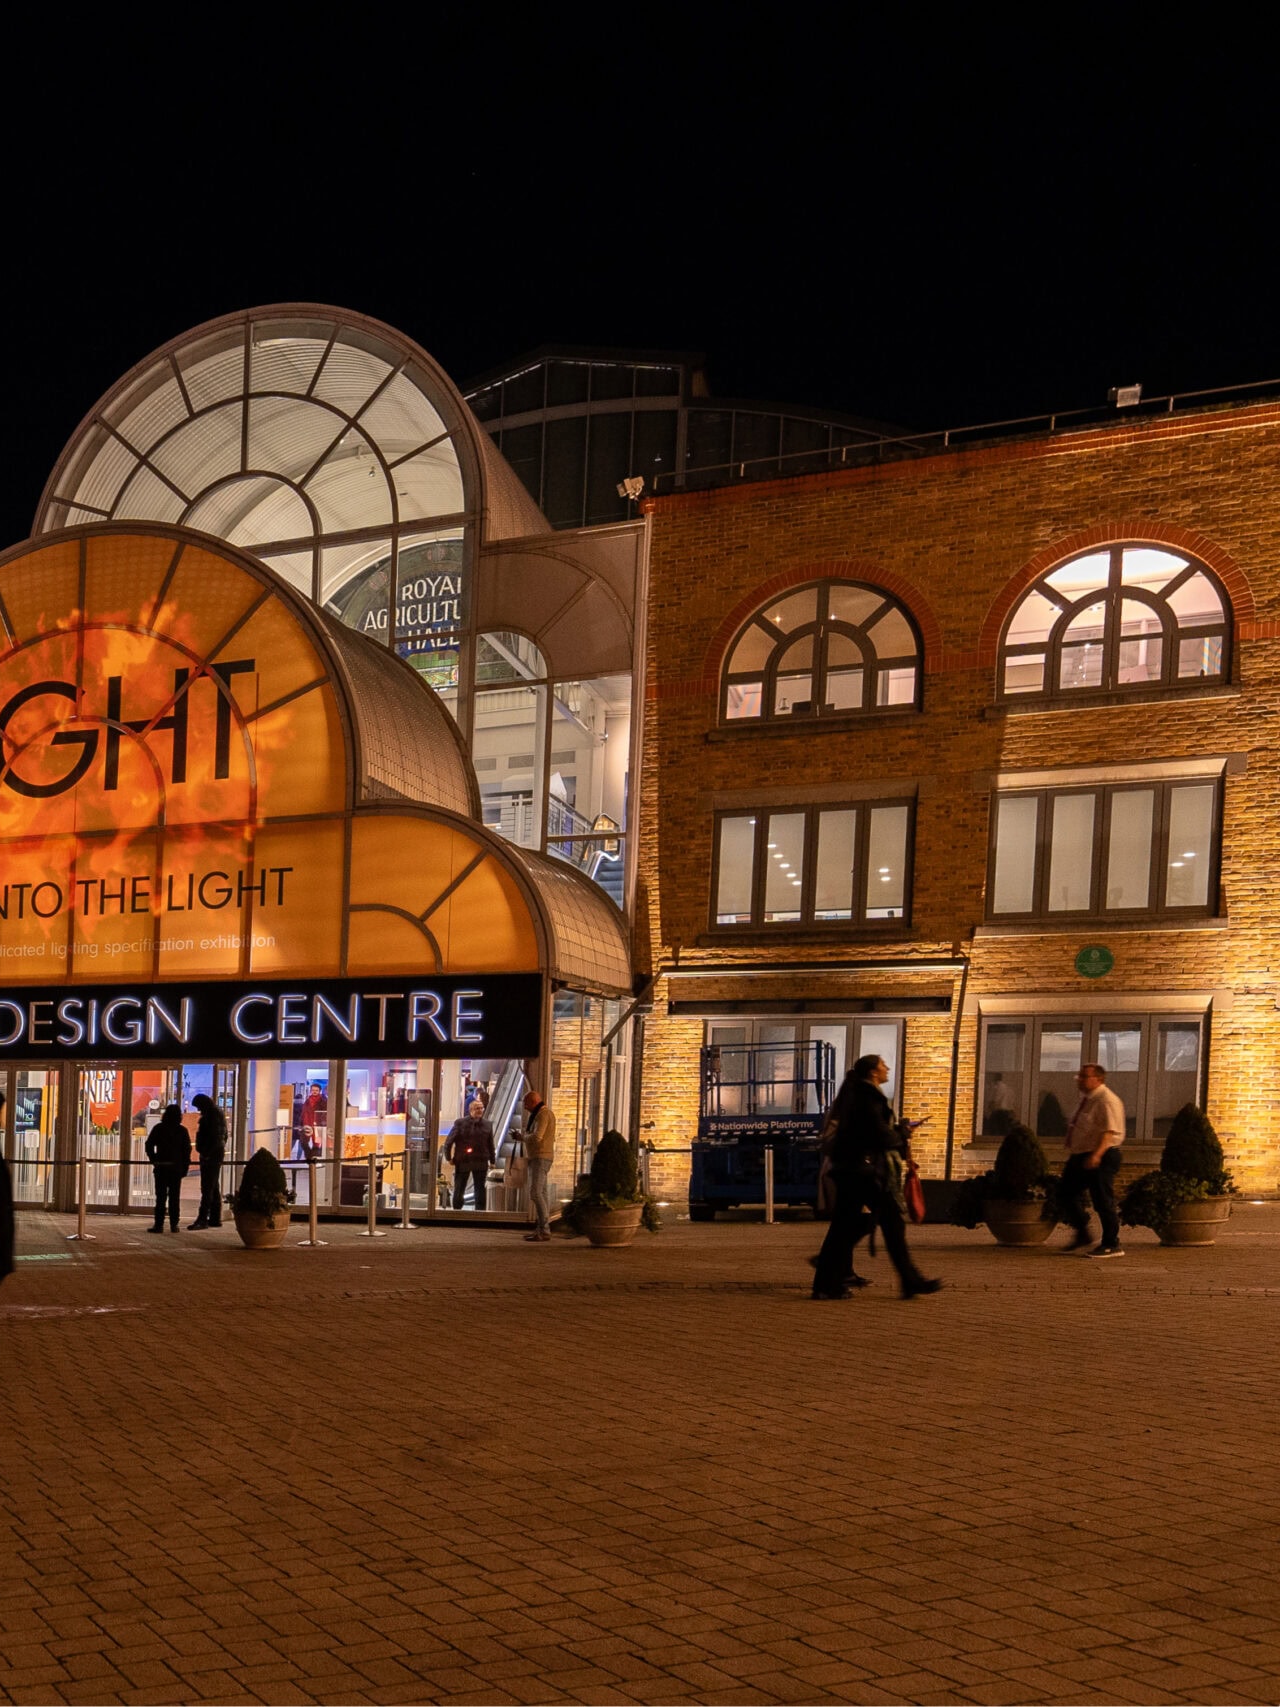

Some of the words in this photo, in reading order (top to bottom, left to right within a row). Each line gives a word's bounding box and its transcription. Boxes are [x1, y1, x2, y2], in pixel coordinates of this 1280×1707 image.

[407, 625, 460, 650] HALL
[77, 876, 150, 916] THE
[167, 867, 294, 912] LIGHT
[51, 941, 98, 959] ligting
[230, 991, 484, 1044] CENTRE
[718, 1121, 768, 1130] Nationwide
[770, 1120, 814, 1129] Platforms
